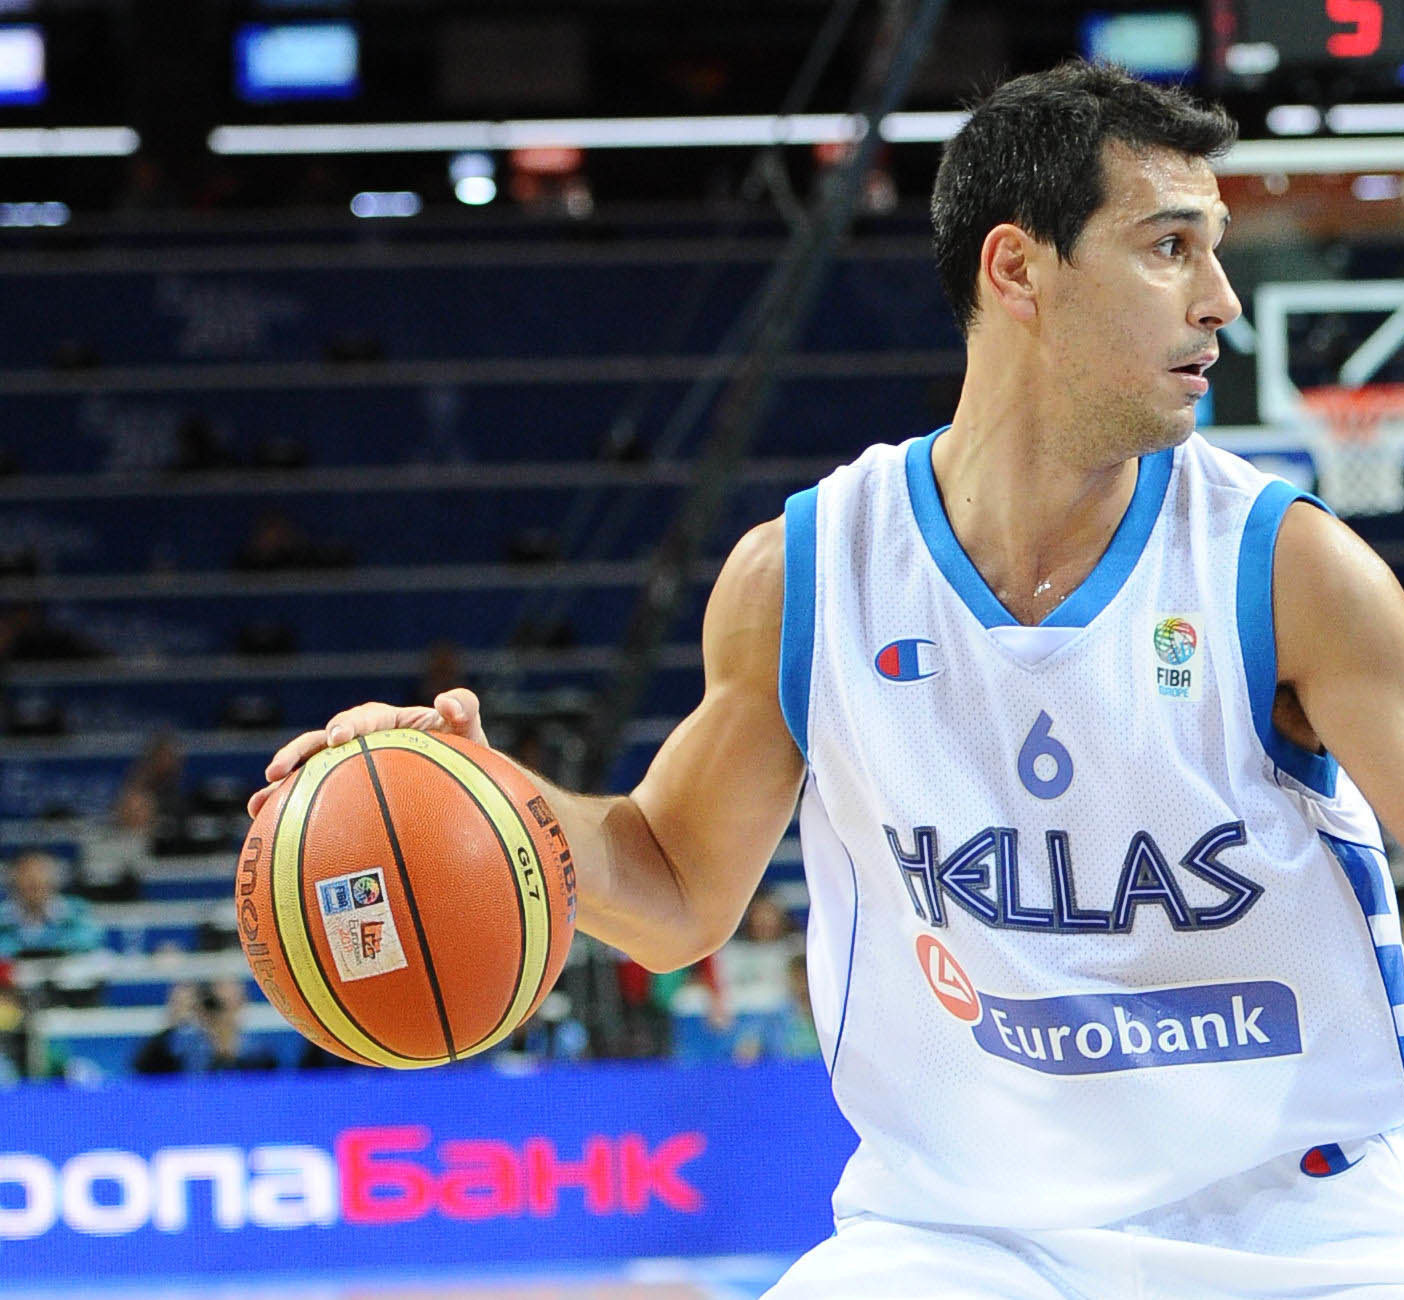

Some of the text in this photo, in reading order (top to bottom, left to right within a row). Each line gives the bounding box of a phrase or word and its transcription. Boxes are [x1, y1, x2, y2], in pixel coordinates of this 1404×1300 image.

[1156, 667, 1191, 687] FIBA
[1017, 709, 1074, 800] 6
[336, 885, 349, 908] FIBA
[517, 846, 541, 901] GL7
[882, 819, 1266, 935] HELLAS
[992, 994, 1271, 1062] Eurobank
